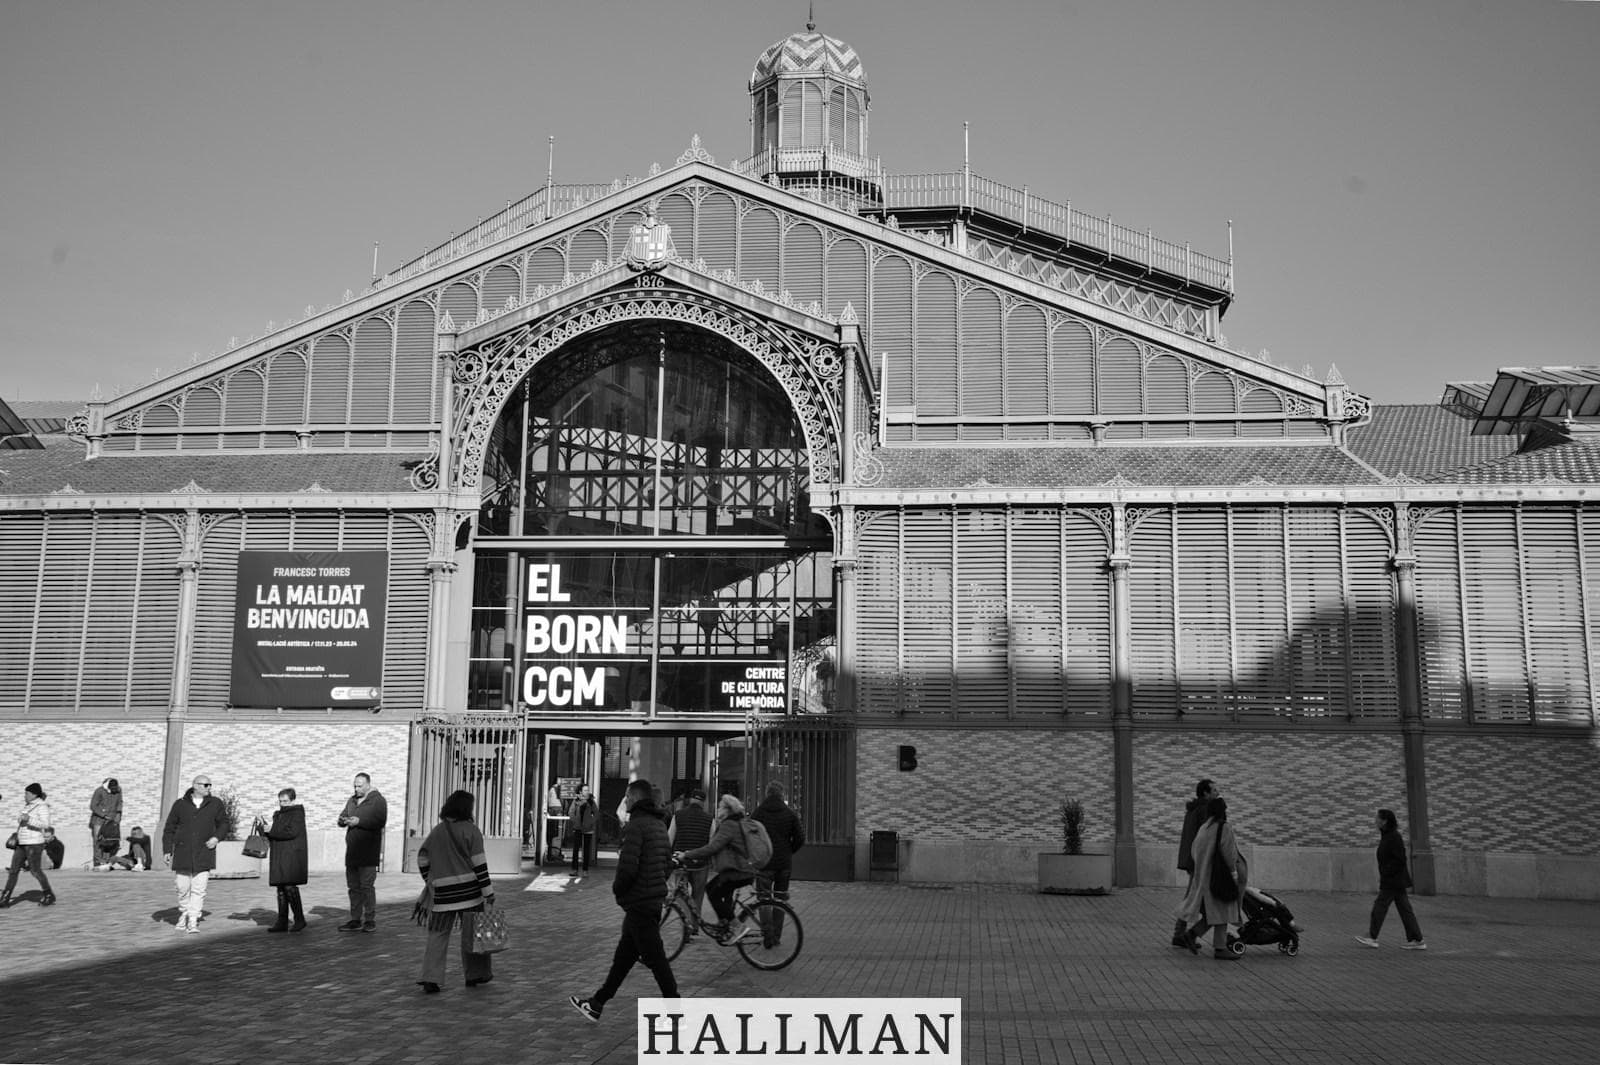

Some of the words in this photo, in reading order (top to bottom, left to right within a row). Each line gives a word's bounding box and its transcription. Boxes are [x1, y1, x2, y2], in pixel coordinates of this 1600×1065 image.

[273, 567, 317, 577] FRANCESC
[318, 567, 351, 577] TORRES
[528, 563, 571, 602] EL
[256, 584, 281, 605] LA
[286, 584, 365, 605] MALDAT
[247, 608, 370, 629] BENVINGUDA
[526, 615, 628, 654] BORN
[745, 667, 785, 680] CENTRE
[523, 666, 605, 706] CCM
[721, 681, 736, 694] DE
[737, 681, 785, 694] CULTURA
[730, 695, 734, 708] I
[735, 694, 785, 708] MEMÒRIA
